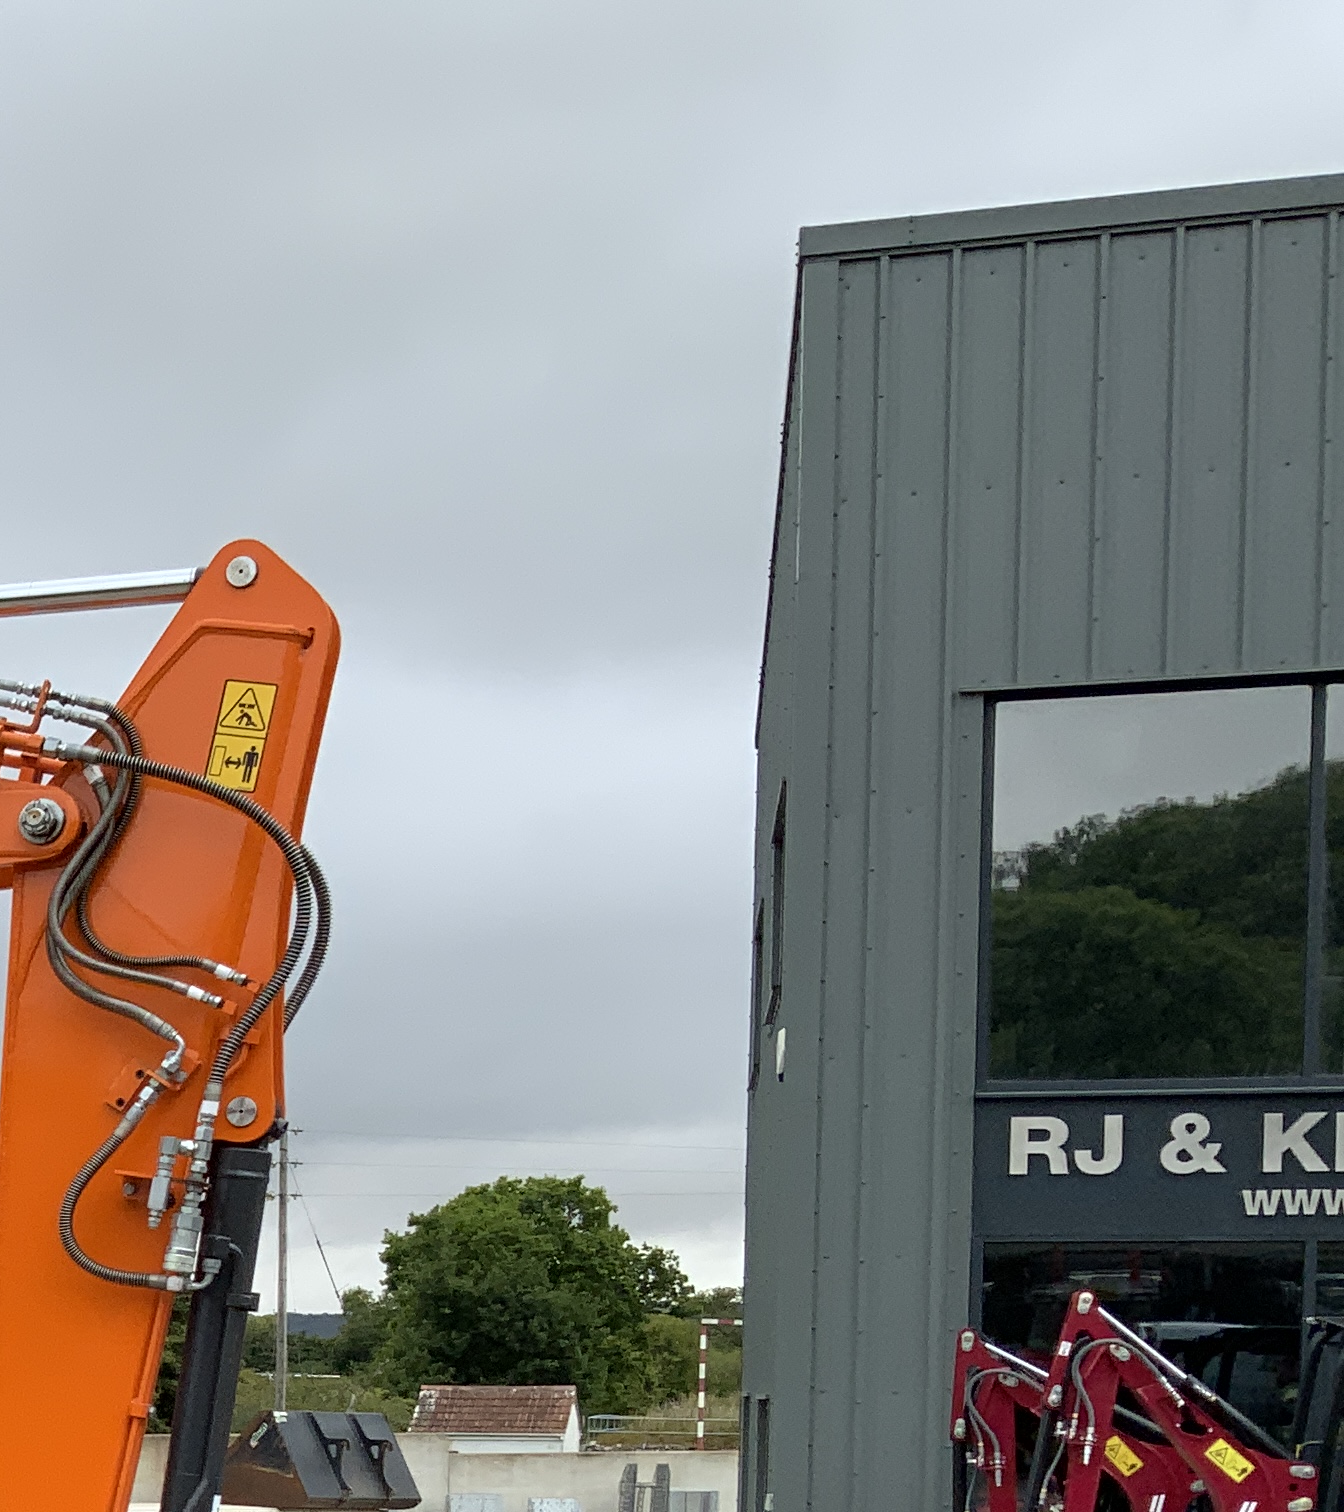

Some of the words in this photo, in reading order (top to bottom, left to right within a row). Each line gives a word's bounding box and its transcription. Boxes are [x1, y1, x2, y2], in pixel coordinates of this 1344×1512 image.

[1009, 1114, 1124, 1176] RJ
[1160, 1112, 1228, 1175] &
[1262, 1111, 1344, 1173] K
